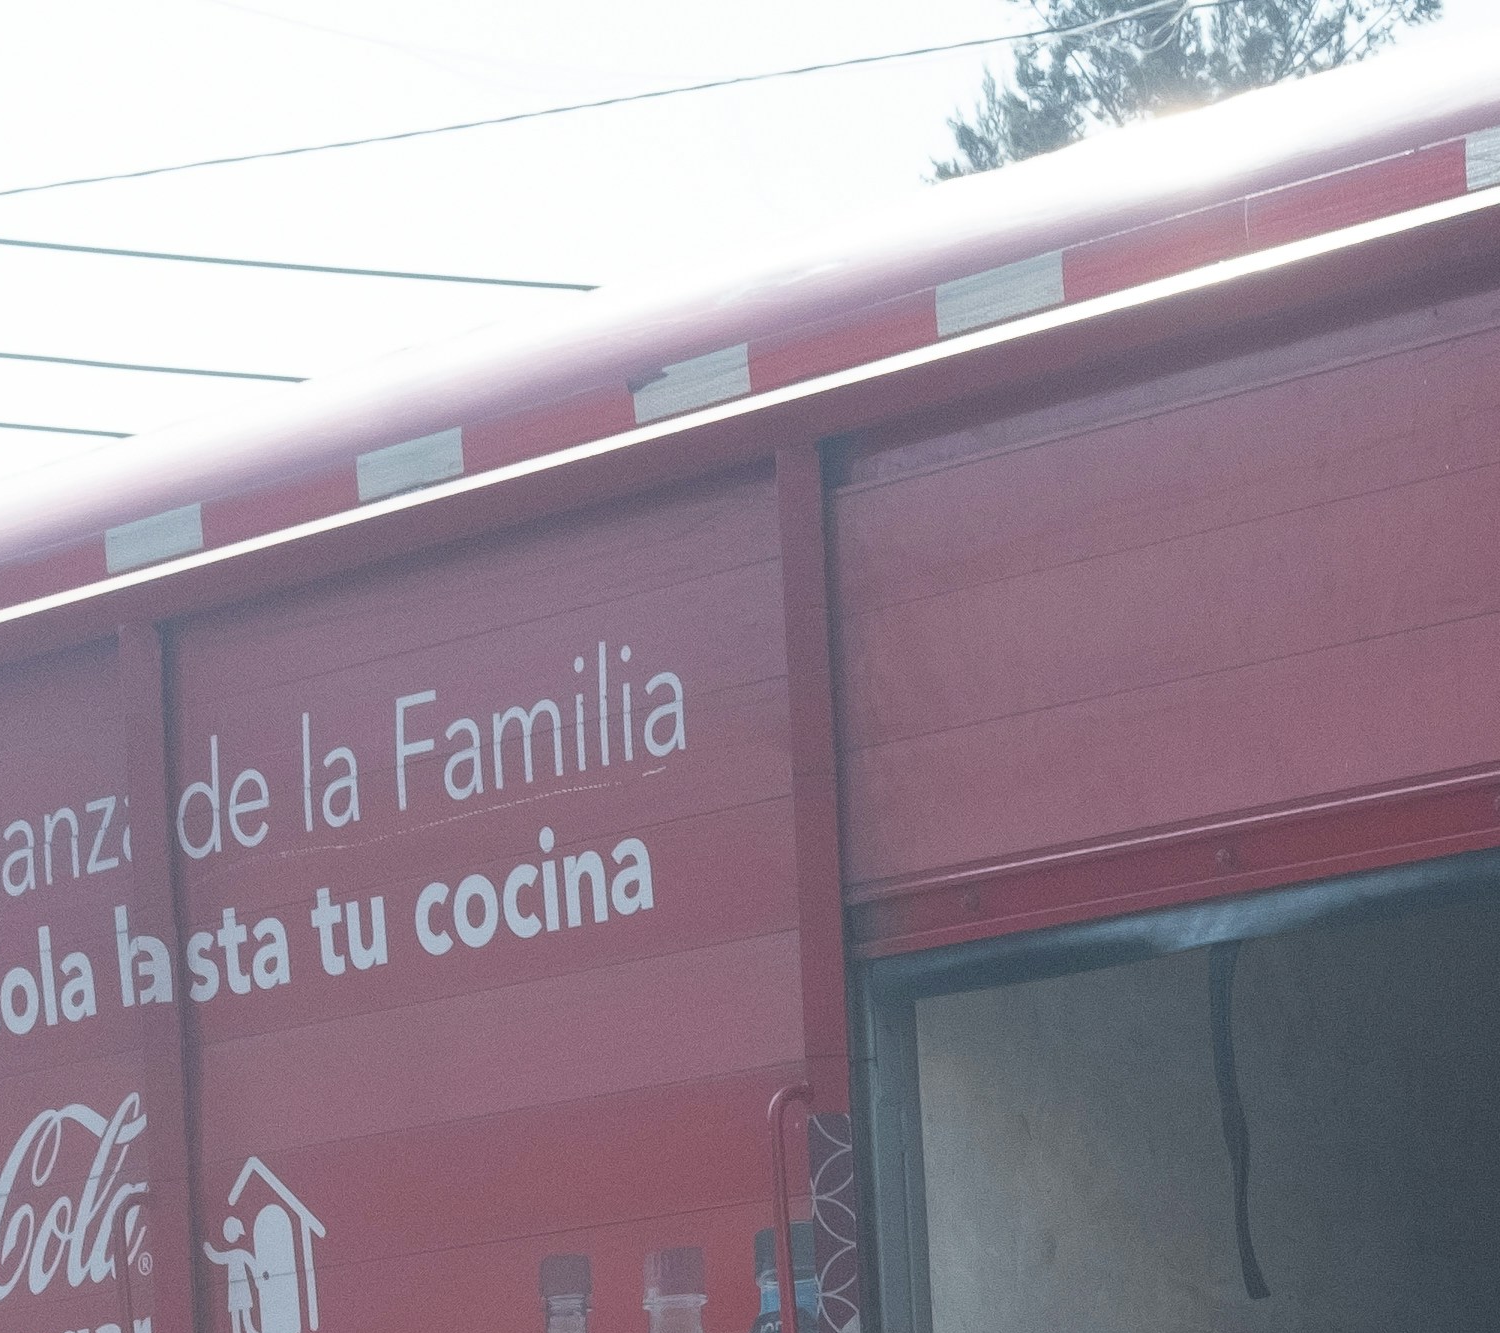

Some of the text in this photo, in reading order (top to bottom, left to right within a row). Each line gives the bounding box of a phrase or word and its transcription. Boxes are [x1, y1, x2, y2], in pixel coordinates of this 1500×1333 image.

[177, 734, 271, 860] de
[302, 711, 361, 833] la
[395, 641, 687, 812] Familia
[311, 886, 388, 977] tu
[414, 825, 655, 957] cocina
